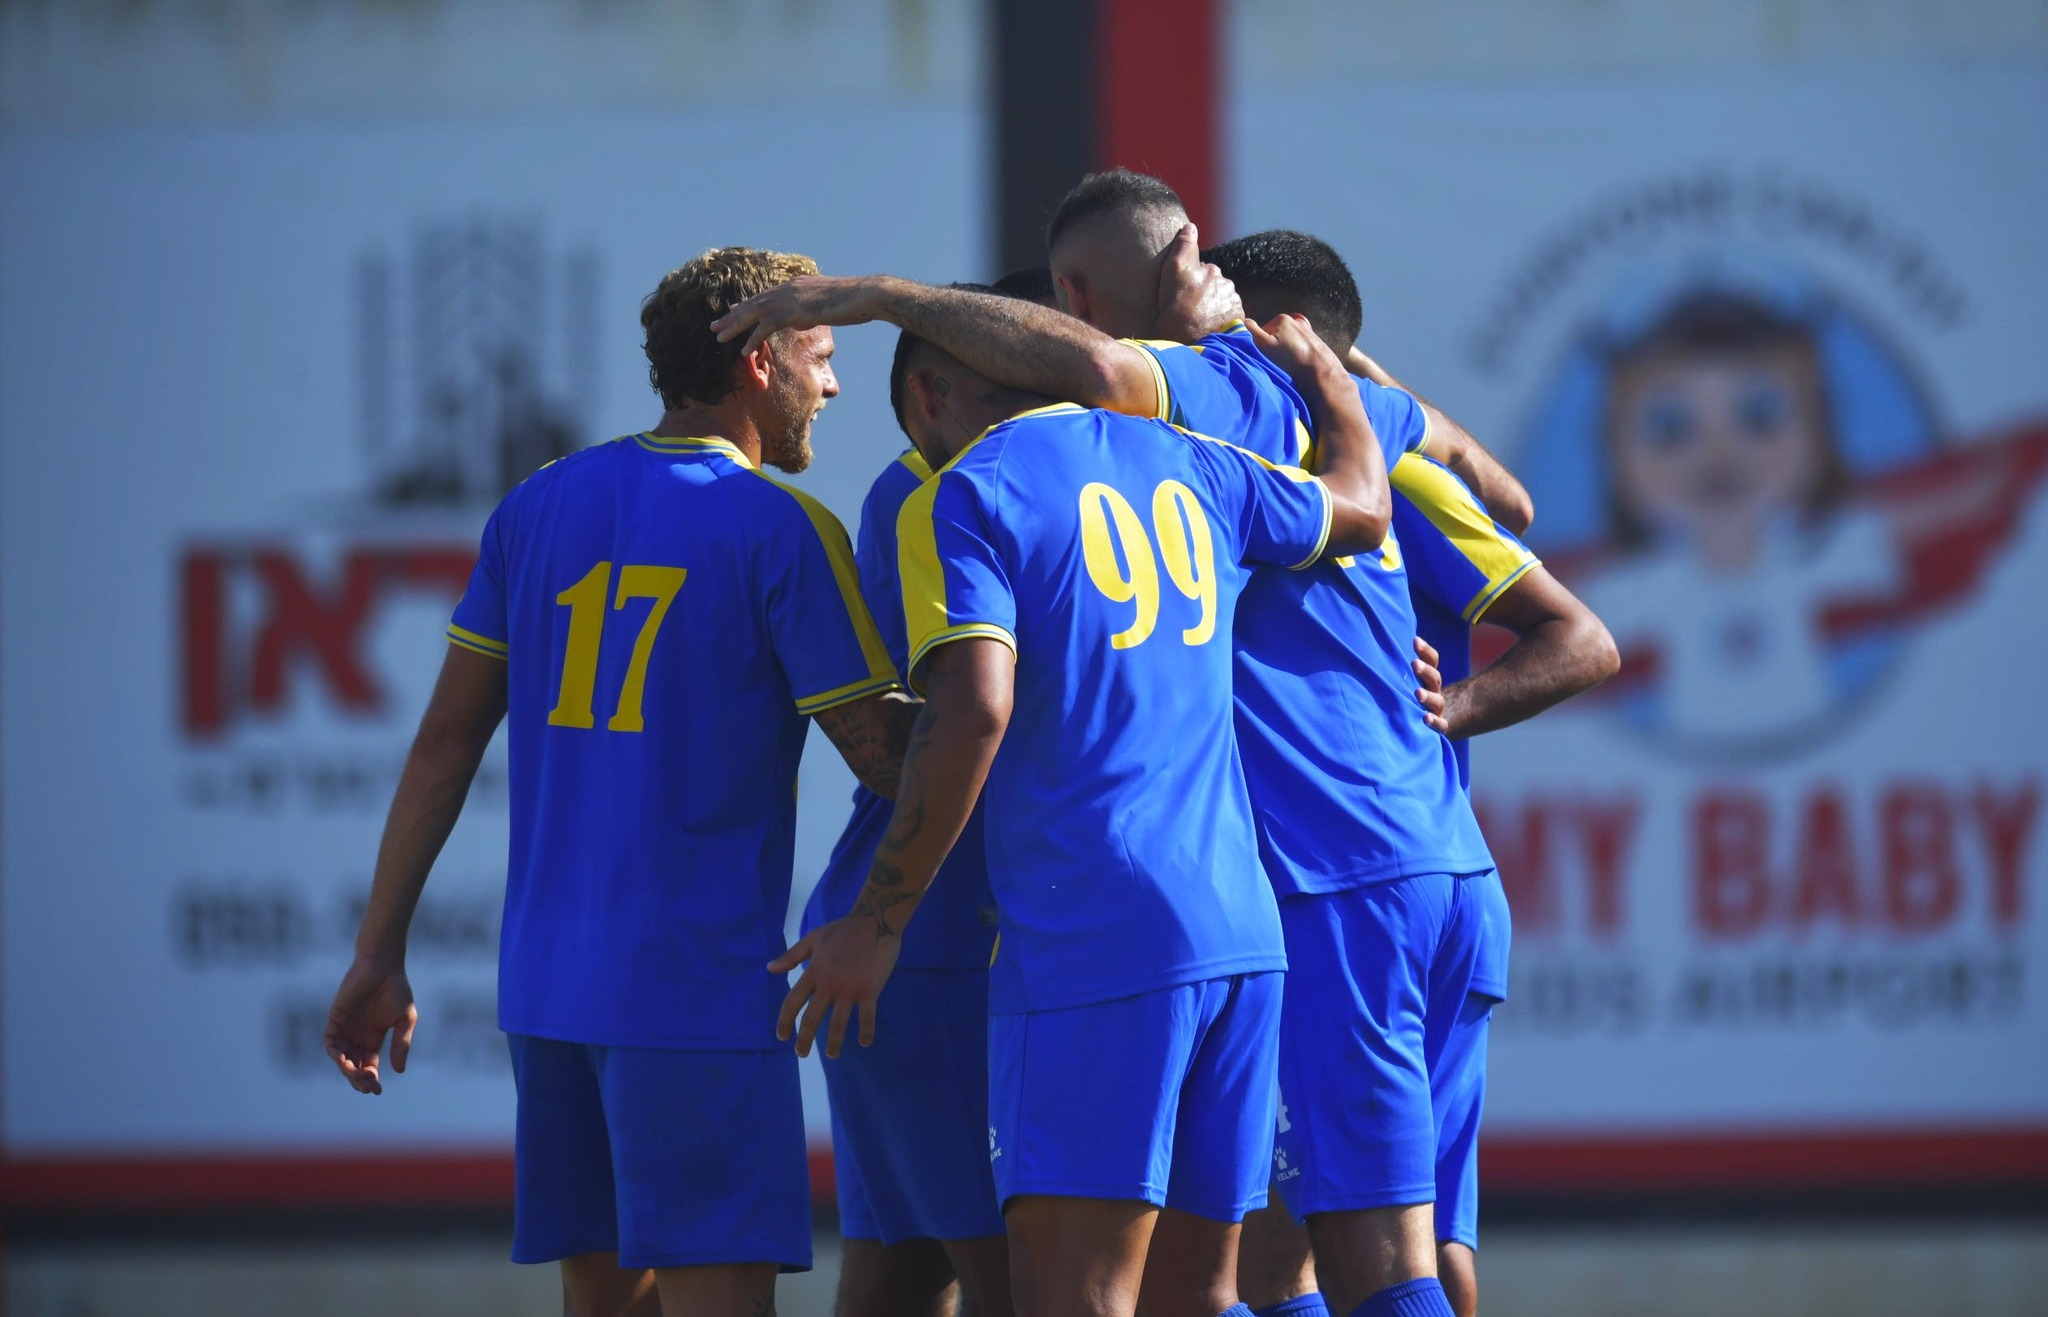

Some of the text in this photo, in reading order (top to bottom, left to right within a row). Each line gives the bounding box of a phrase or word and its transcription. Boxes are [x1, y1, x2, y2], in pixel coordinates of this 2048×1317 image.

[548, 560, 688, 733] 17
[1079, 479, 1217, 650] 99
[1692, 775, 2038, 941] BABY
